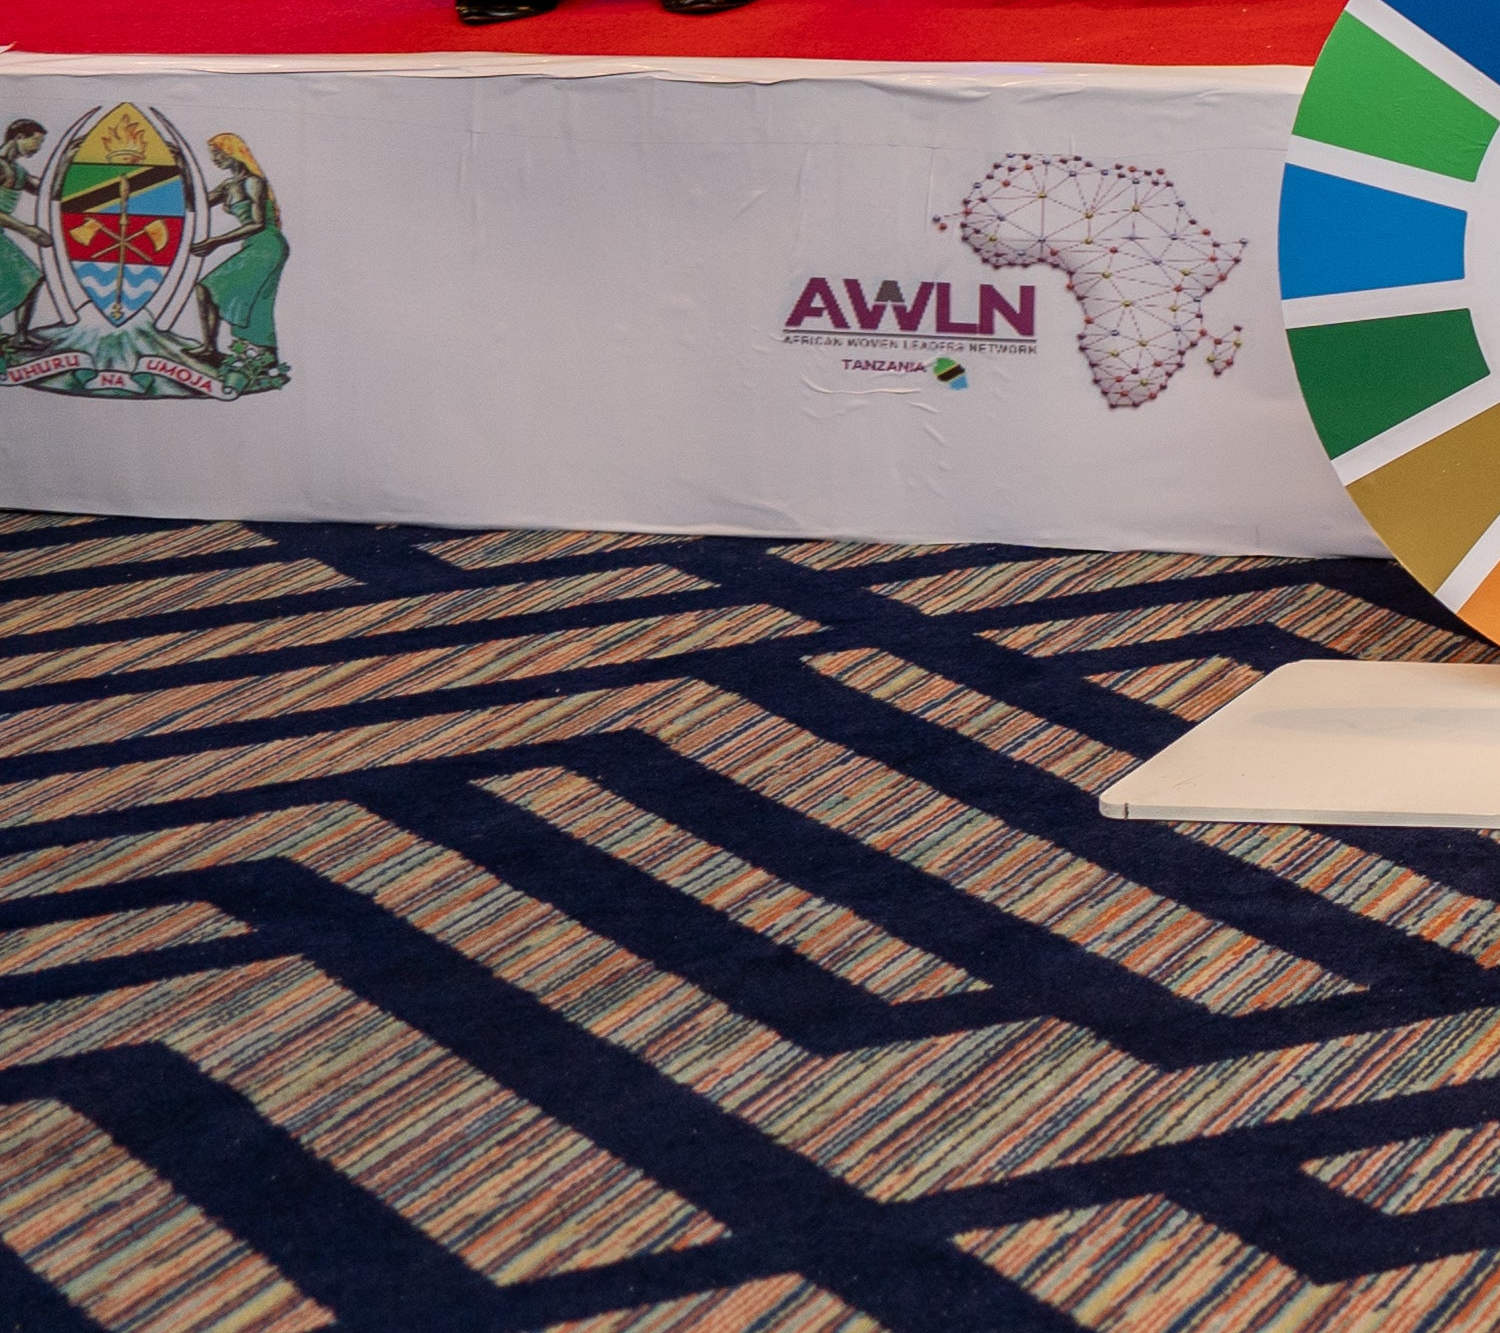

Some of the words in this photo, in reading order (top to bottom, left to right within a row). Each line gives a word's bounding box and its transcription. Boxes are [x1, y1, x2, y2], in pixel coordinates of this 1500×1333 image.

[784, 276, 1036, 338] AWLN
[783, 335, 843, 347] AFRICAN
[969, 342, 1038, 356] NETWORK
[8, 354, 81, 383] UHURU
[100, 373, 125, 387] NA
[146, 358, 213, 393] UMOJA
[841, 358, 927, 375] TANZANIA
